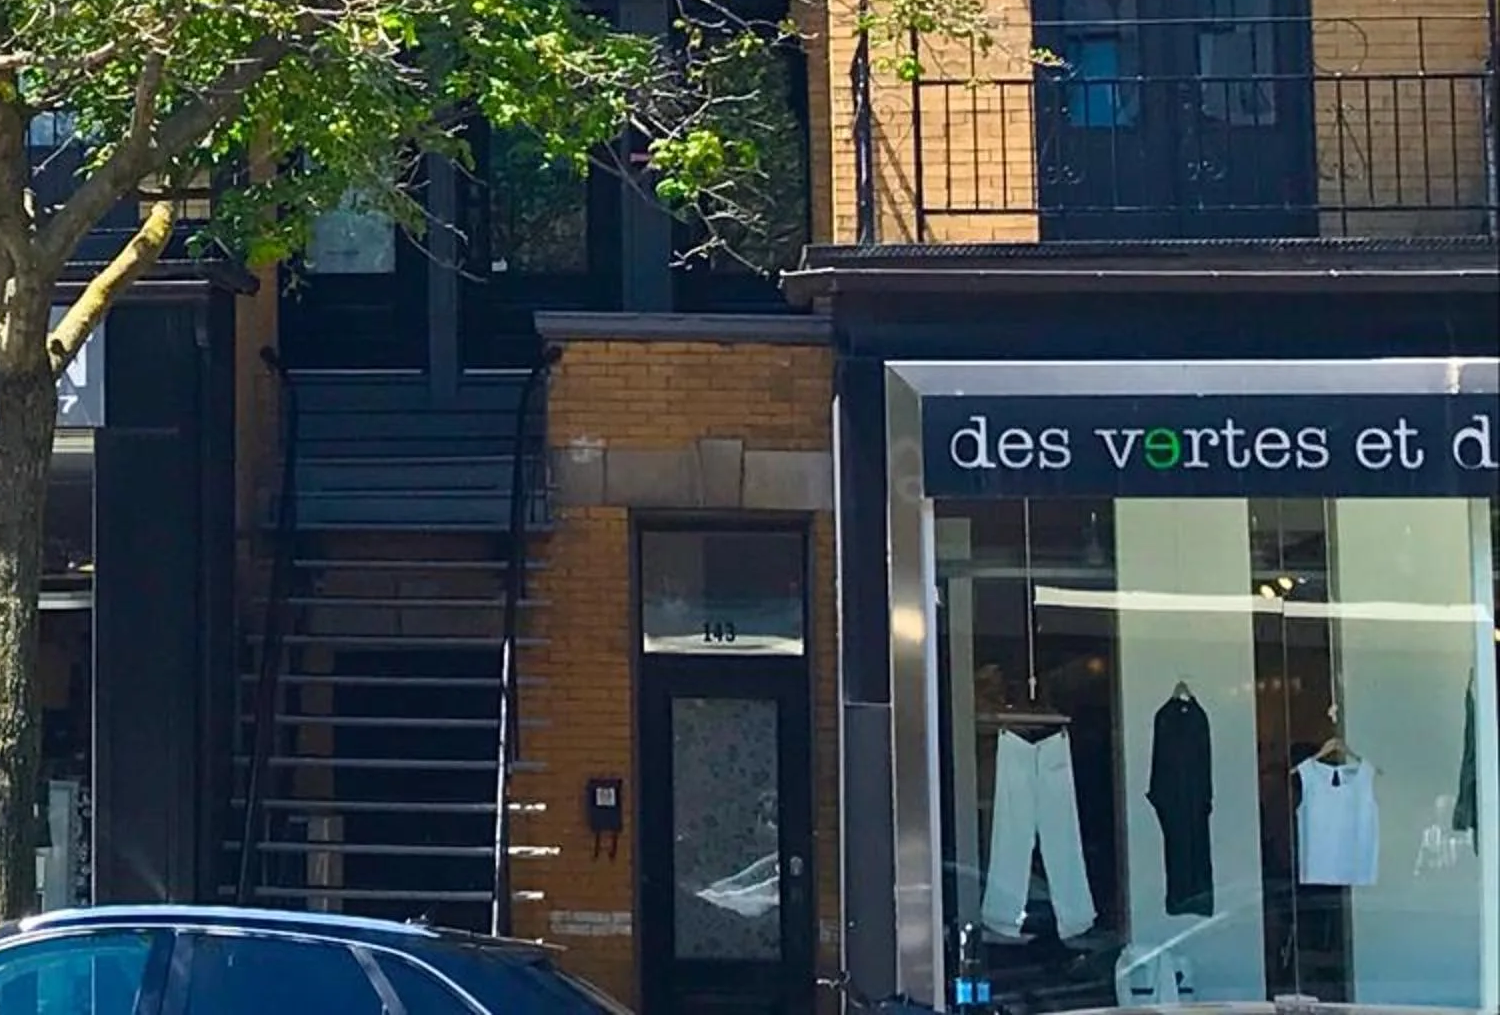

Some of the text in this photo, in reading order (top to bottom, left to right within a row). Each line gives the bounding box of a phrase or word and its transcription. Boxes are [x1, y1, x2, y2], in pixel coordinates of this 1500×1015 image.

[950, 415, 1072, 469] des
[1355, 417, 1424, 470] et
[702, 621, 737, 643] 143
